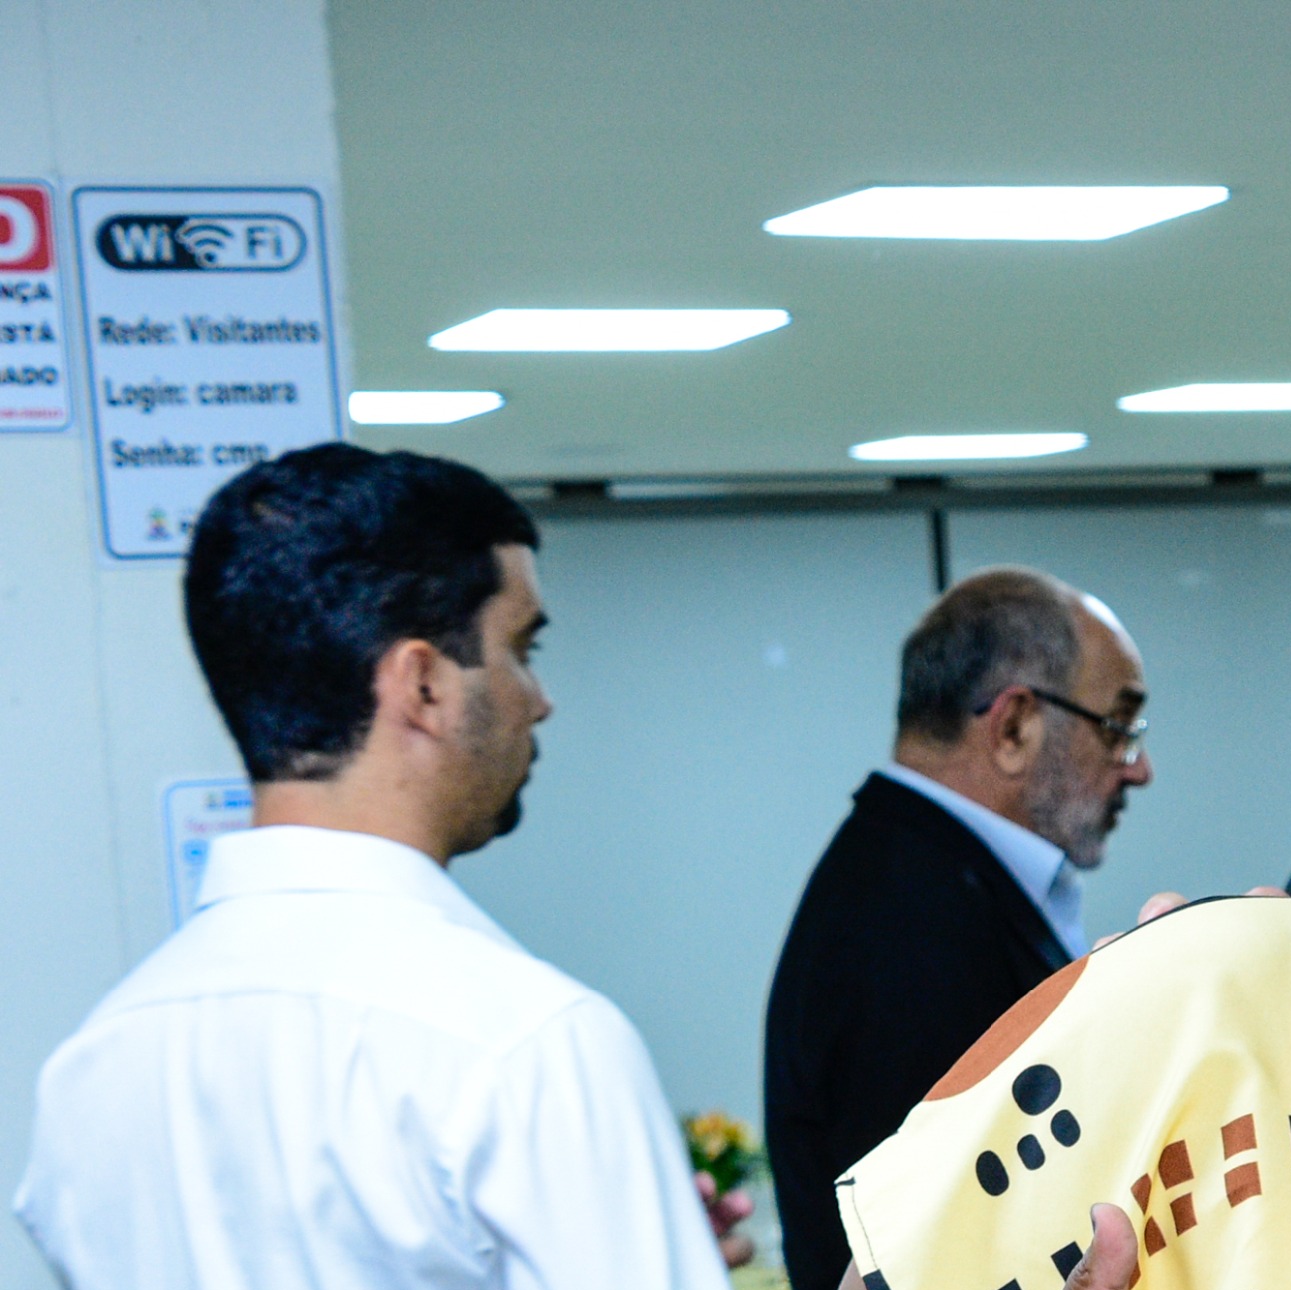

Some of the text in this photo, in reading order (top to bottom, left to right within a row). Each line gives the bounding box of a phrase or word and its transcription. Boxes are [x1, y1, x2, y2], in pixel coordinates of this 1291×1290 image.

[111, 223, 284, 263] Wi Fi
[98, 314, 320, 344] Rede: Visitantes
[104, 376, 297, 414] Login: camara
[111, 437, 203, 468] Senha:
